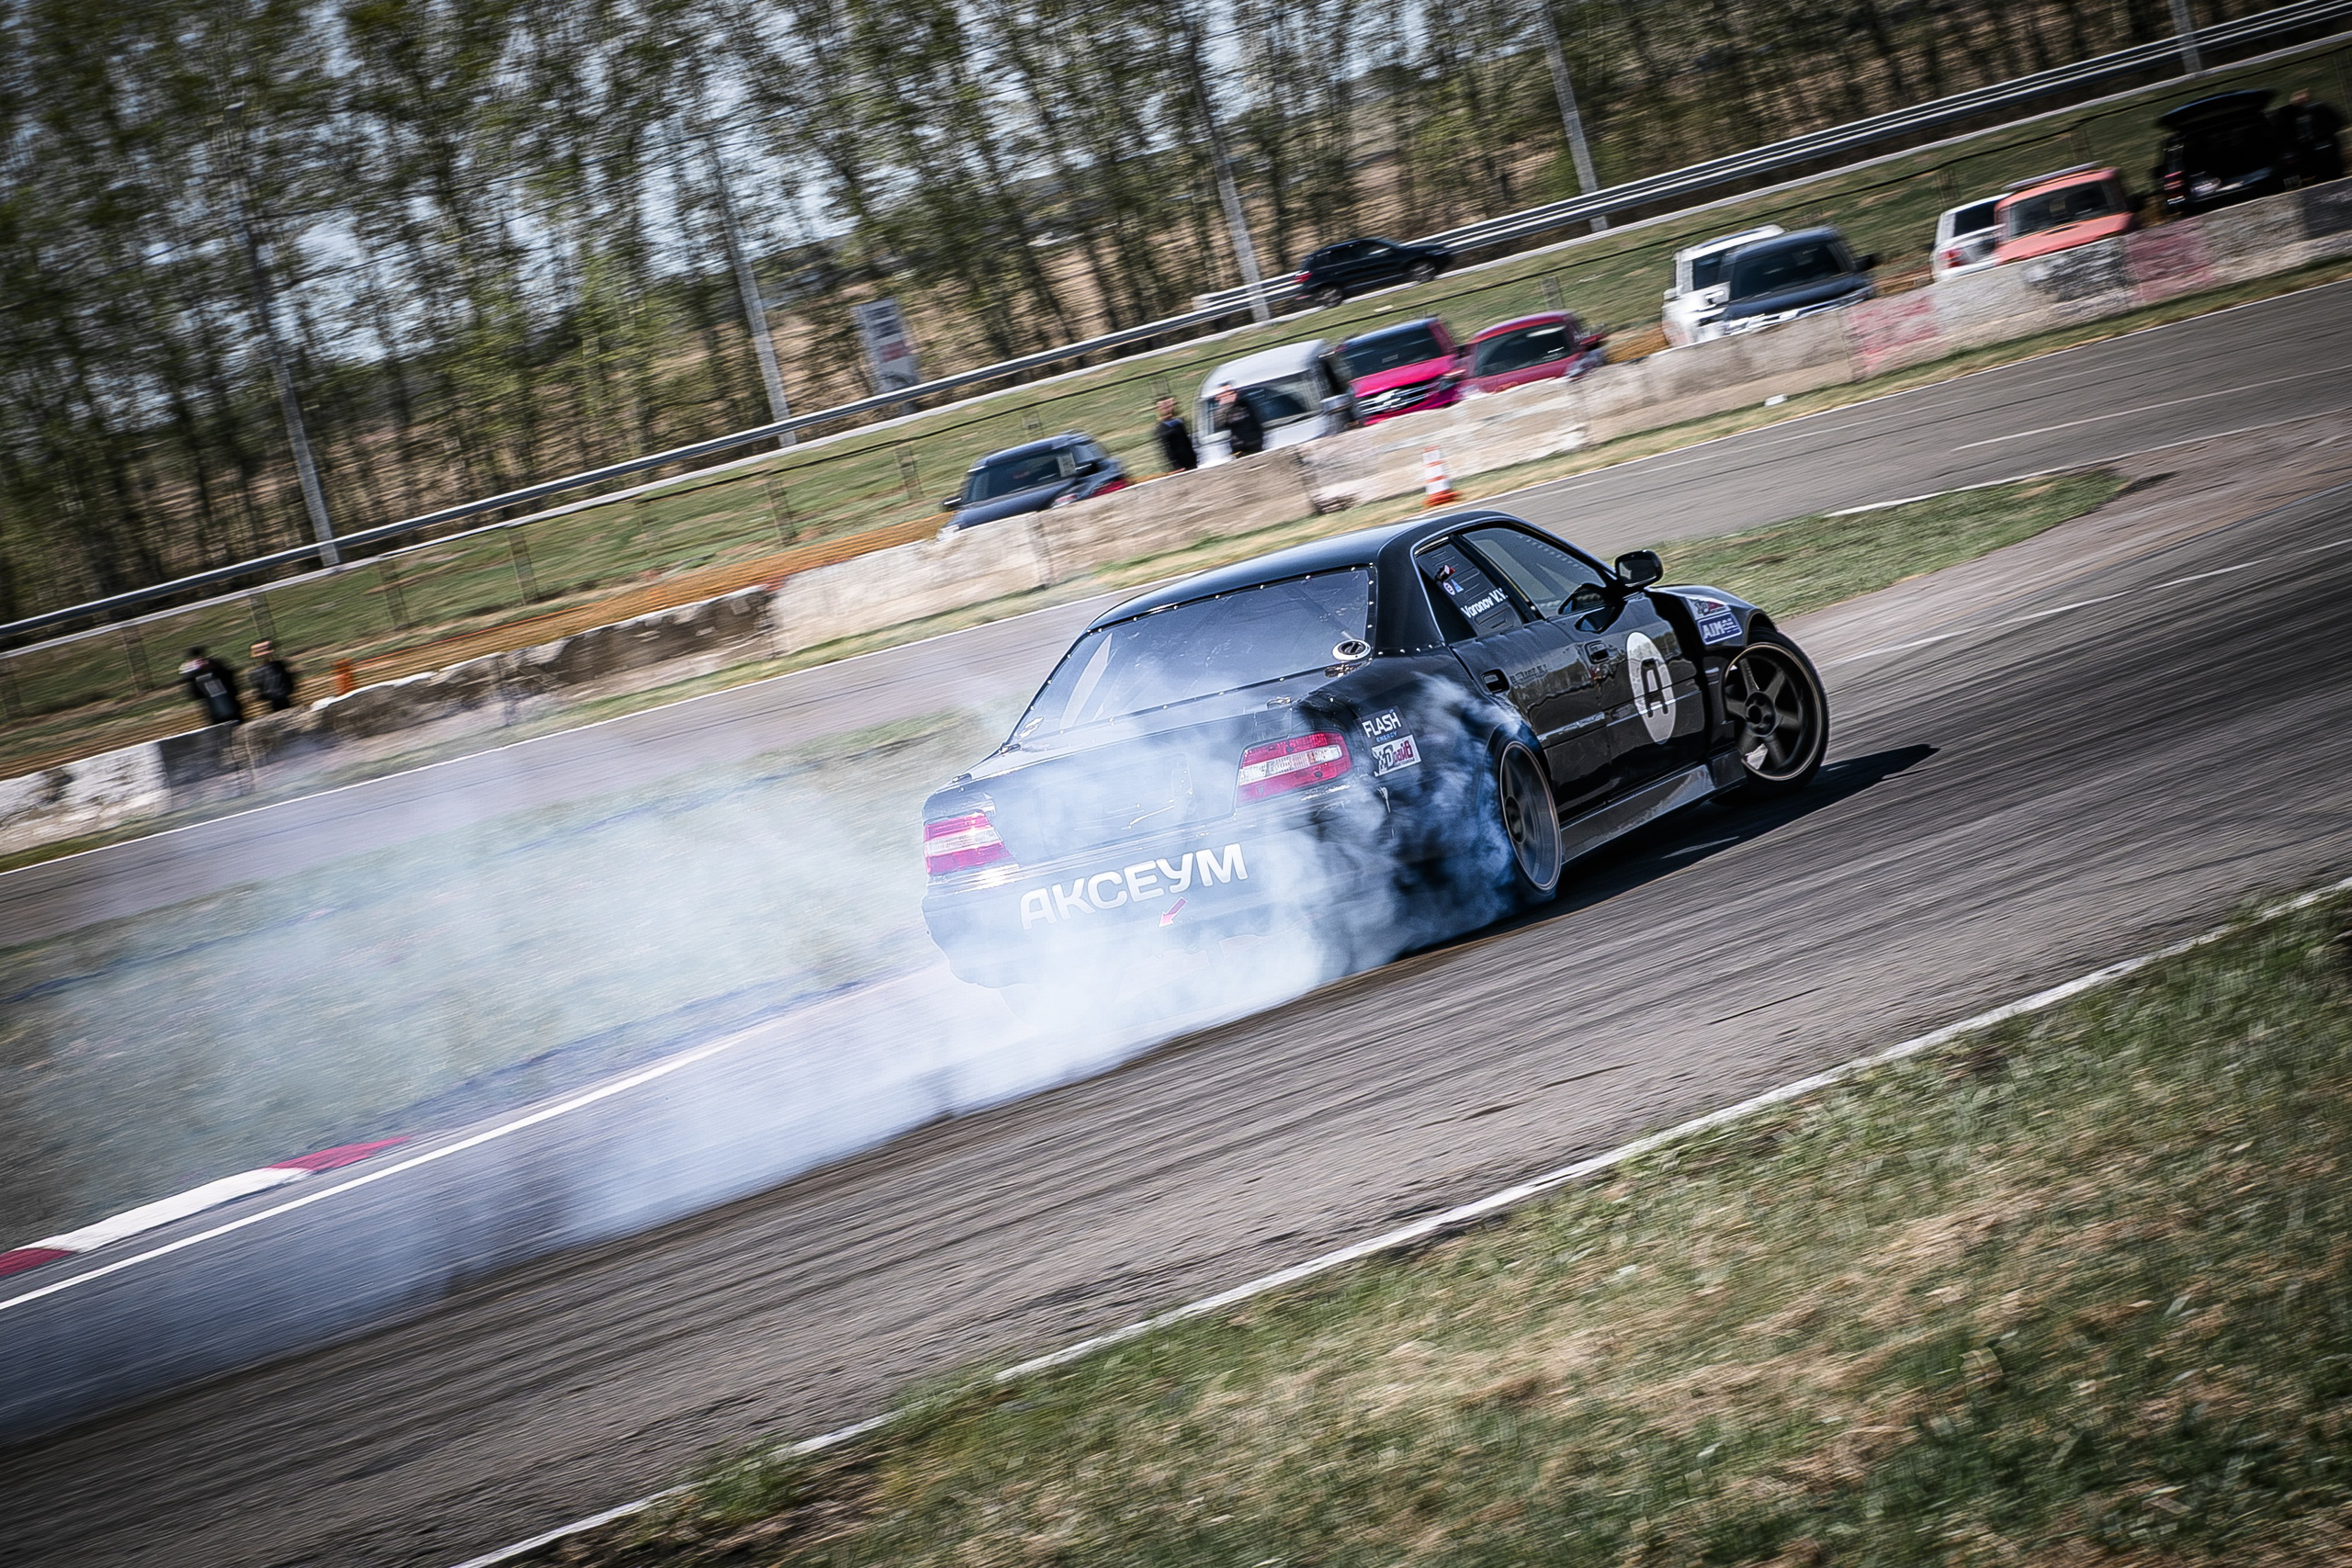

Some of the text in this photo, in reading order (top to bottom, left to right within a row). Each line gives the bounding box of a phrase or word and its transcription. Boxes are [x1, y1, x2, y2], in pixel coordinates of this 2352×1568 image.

[1461, 596, 1495, 618] Voronov
[1362, 712, 1402, 739] FLASH
[1019, 842, 1250, 931] АКСЕУМ
